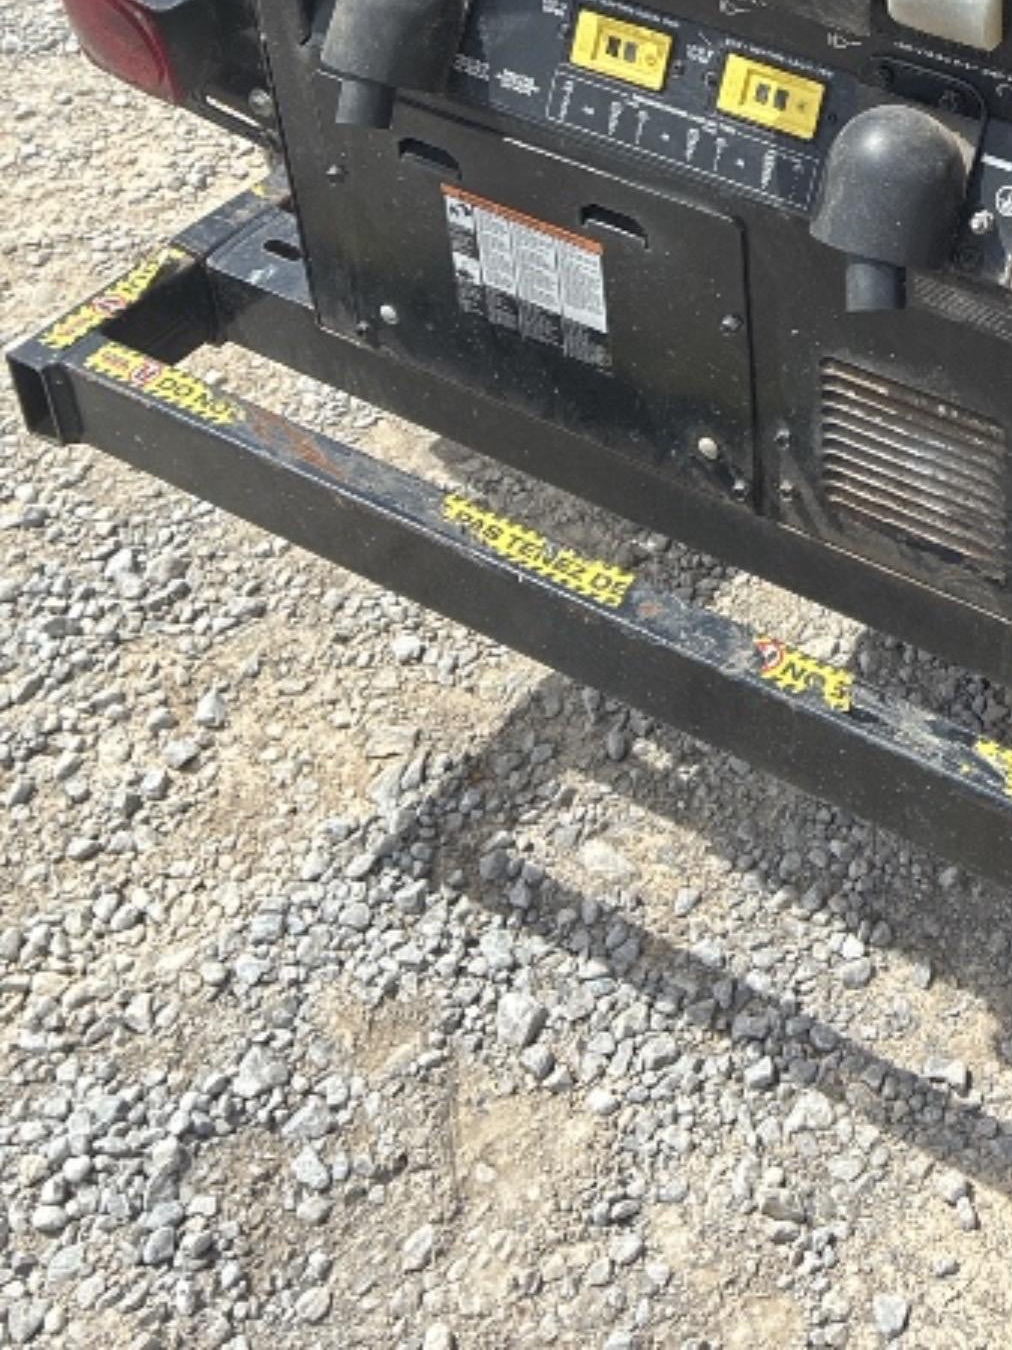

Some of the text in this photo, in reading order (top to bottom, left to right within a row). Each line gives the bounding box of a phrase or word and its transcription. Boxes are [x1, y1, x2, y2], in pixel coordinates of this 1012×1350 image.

[157, 377, 195, 397] DO
[455, 509, 504, 541] PAS
[507, 534, 586, 583] TENEZ
